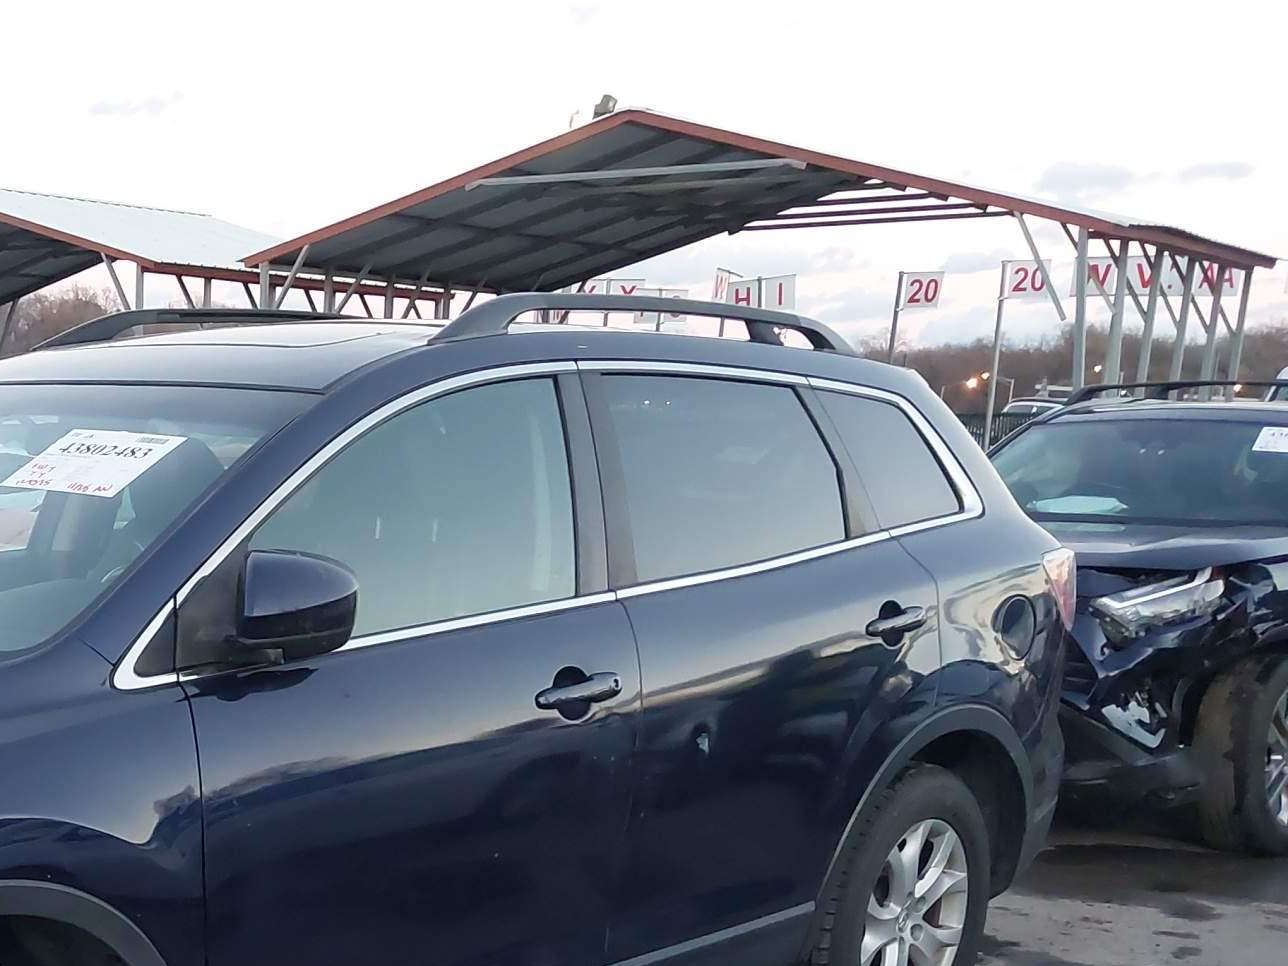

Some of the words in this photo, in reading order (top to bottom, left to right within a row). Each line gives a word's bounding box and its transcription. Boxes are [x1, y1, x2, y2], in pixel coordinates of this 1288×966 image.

[734, 286, 751, 306] H
[907, 278, 939, 304] 20
[58, 442, 153, 459] 43802483
